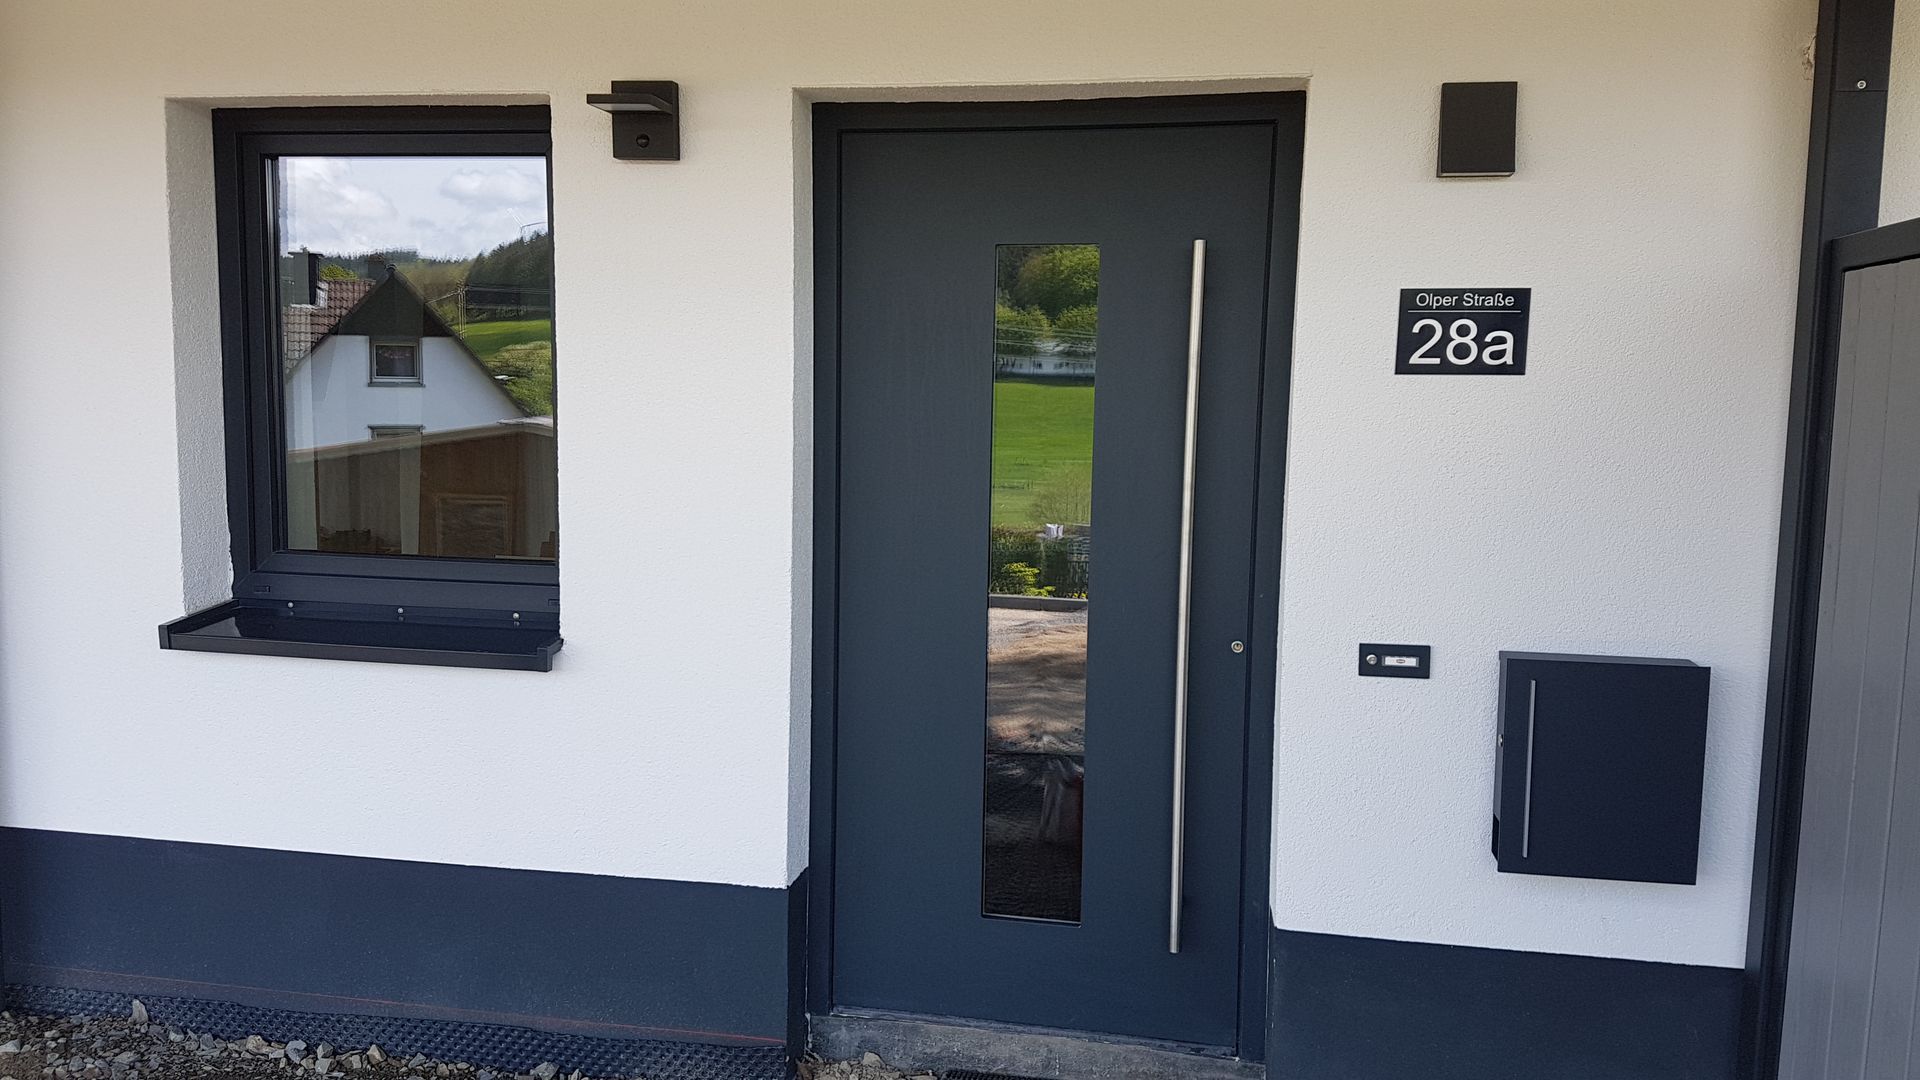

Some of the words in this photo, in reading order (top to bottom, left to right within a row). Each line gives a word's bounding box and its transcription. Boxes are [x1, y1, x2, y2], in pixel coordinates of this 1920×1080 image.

[1416, 292, 1459, 309] Olper
[1462, 292, 1515, 307] Straße
[1408, 318, 1514, 366] 28a
